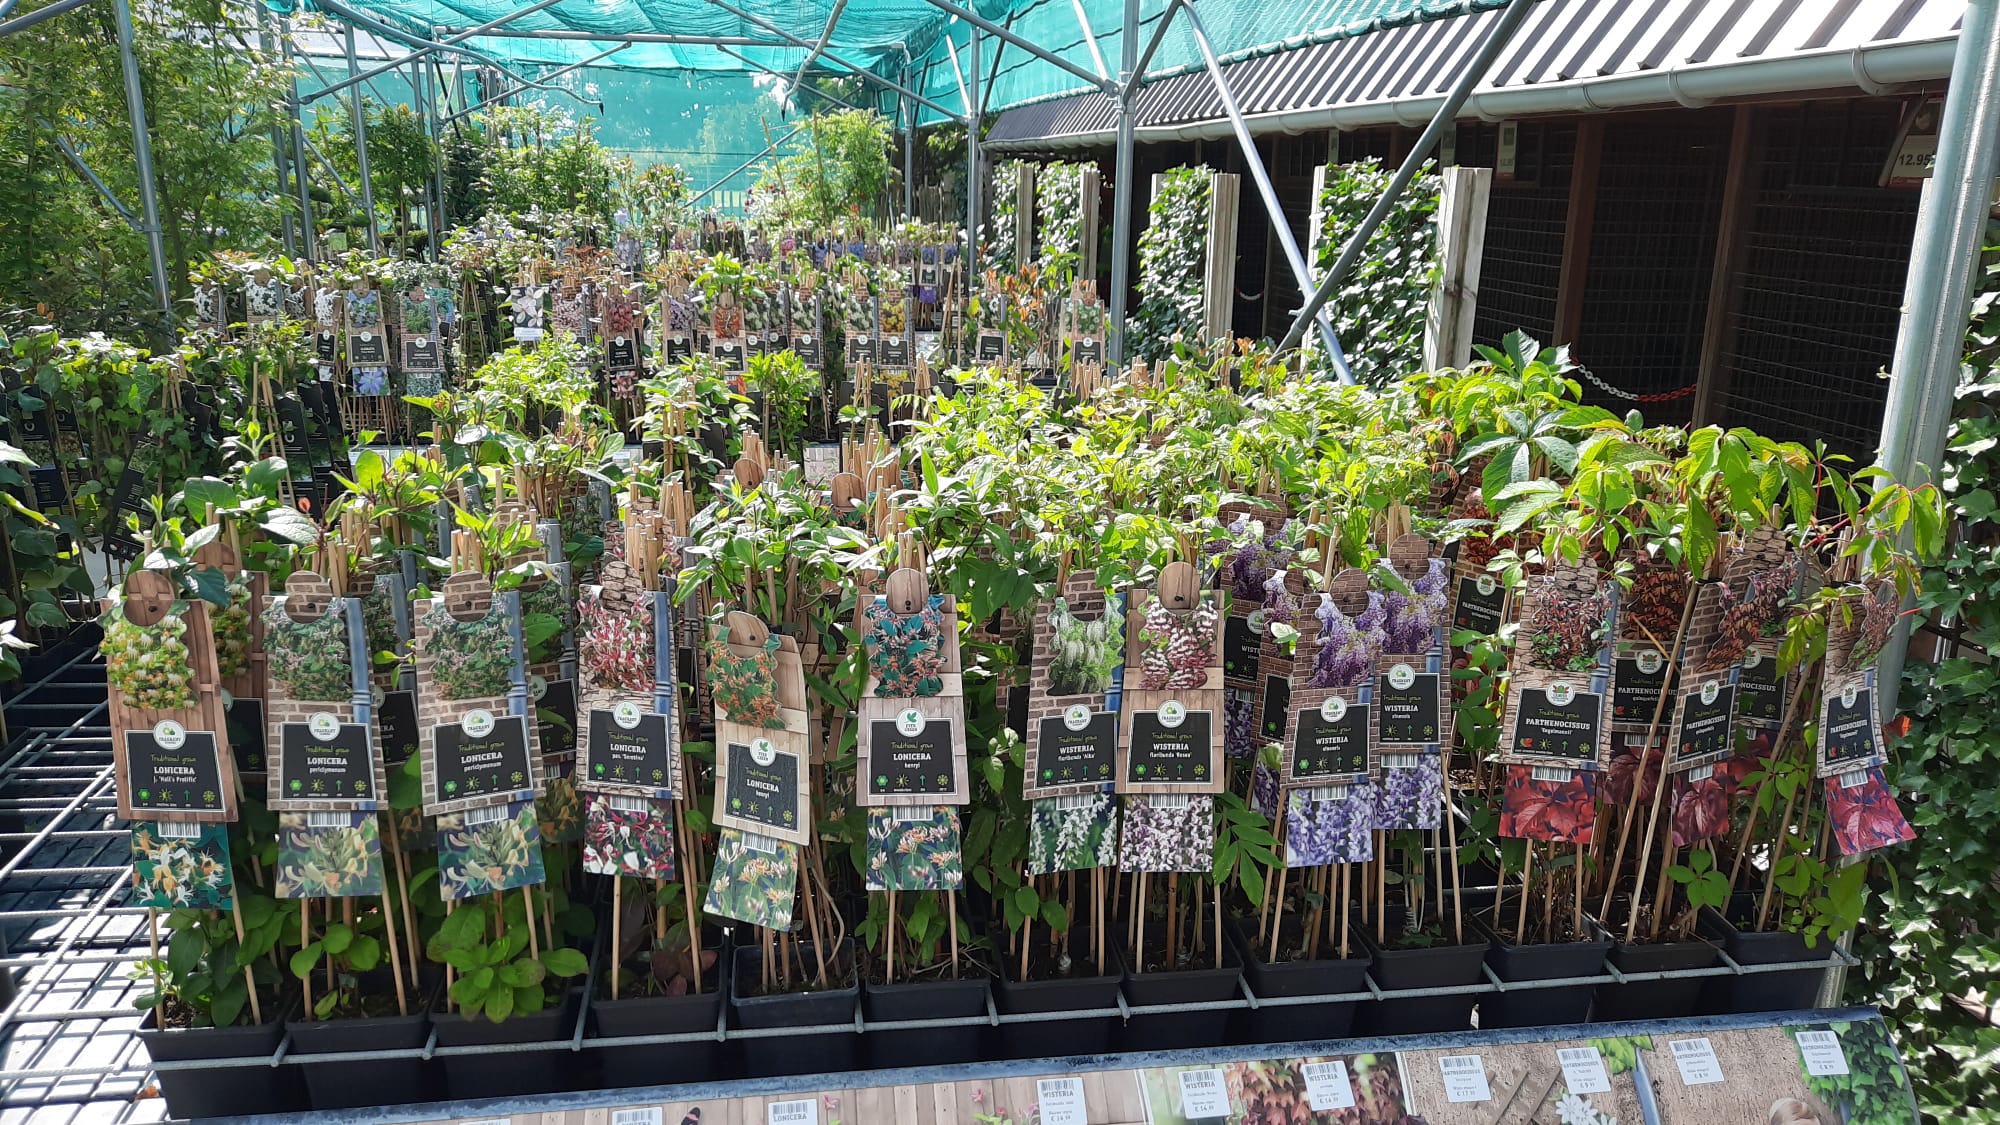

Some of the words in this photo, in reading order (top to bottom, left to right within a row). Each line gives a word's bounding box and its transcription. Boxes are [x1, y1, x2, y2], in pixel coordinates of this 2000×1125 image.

[1900, 153, 1932, 166] 12.95
[1384, 704, 1419, 712] WISTERIA
[1525, 718, 1591, 730] PARTHENOCISSUS
[1315, 736, 1349, 745] WISTERIA
[610, 743, 647, 754] LONICERA
[1059, 744, 1095, 755] WISTERIA
[1153, 743, 1189, 751] WISTERIA
[306, 757, 348, 765] LONICERA
[460, 751, 503, 764] LONICERA
[893, 752, 932, 761] LONICERA
[153, 766, 195, 775] LONICERA
[746, 778, 780, 793] LONICERA
[1185, 1081, 1216, 1089] WISTERIA
[1043, 1090, 1074, 1098] WISTERIA
[773, 1113, 807, 1122] LONICERA
